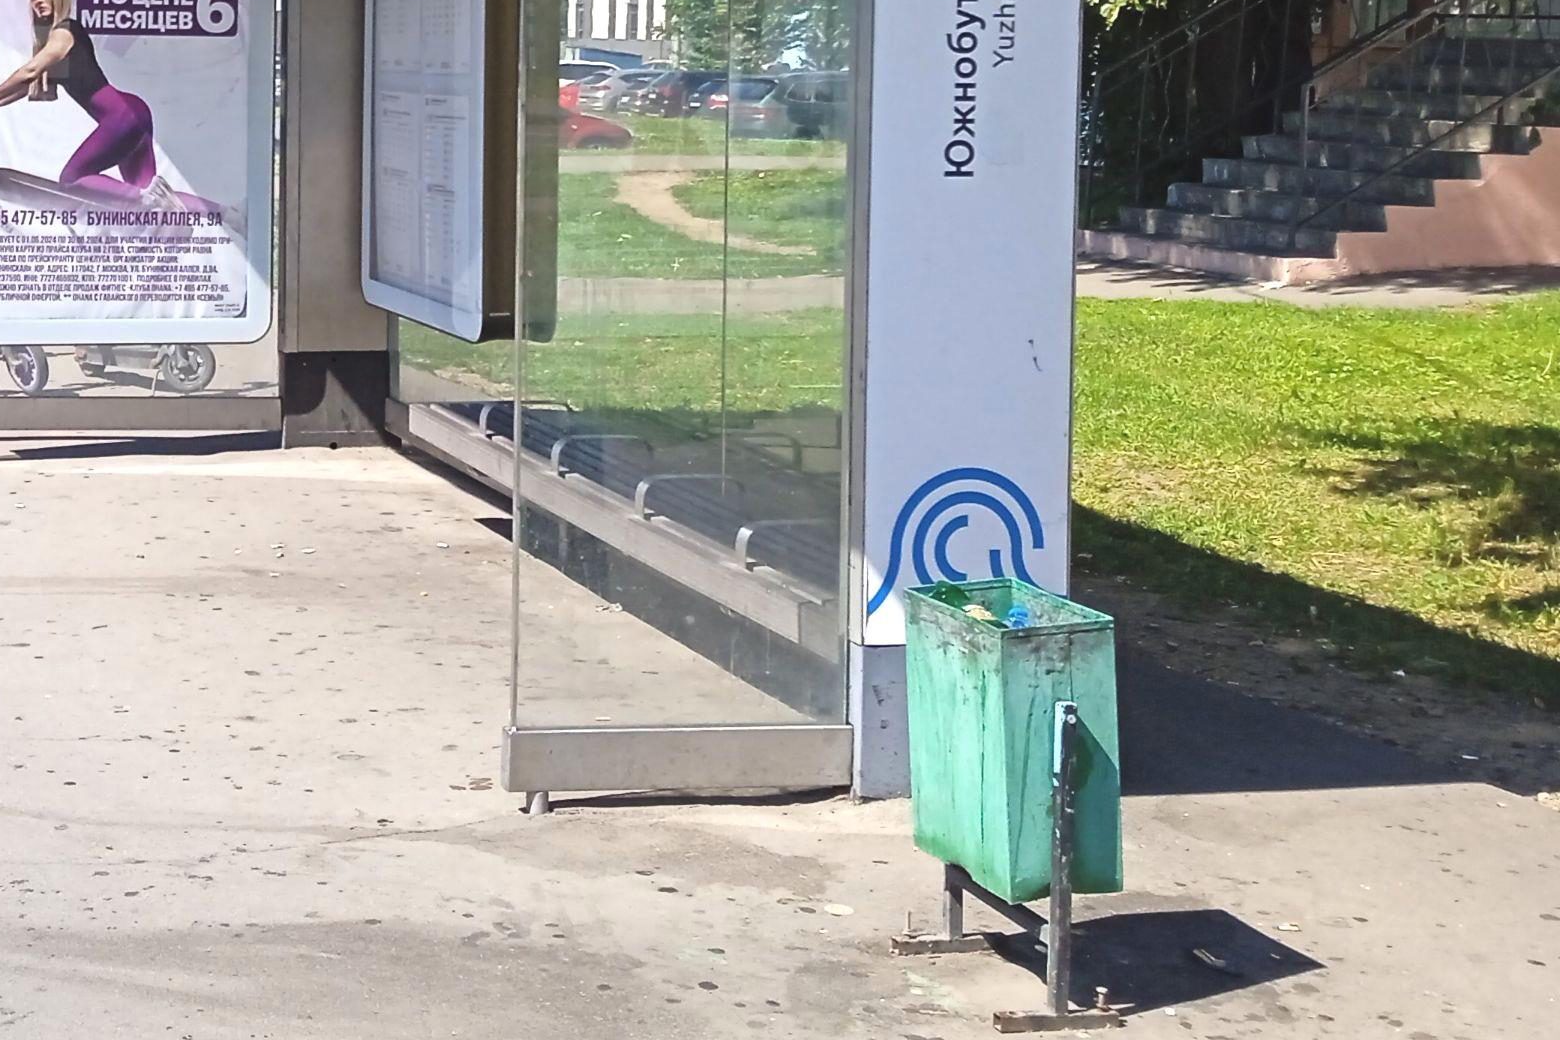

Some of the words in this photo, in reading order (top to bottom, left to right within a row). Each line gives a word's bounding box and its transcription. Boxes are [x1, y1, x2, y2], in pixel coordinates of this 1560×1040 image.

[81, 9, 194, 33] МЕСЯЦЕВ
[11, 210, 77, 226] 477-57-85
[87, 211, 159, 227] БУНИНСКАЯ
[160, 211, 204, 228] АЛЛЕЯ,
[207, 212, 223, 227] 9А
[15, 245, 35, 253] КАРТУ
